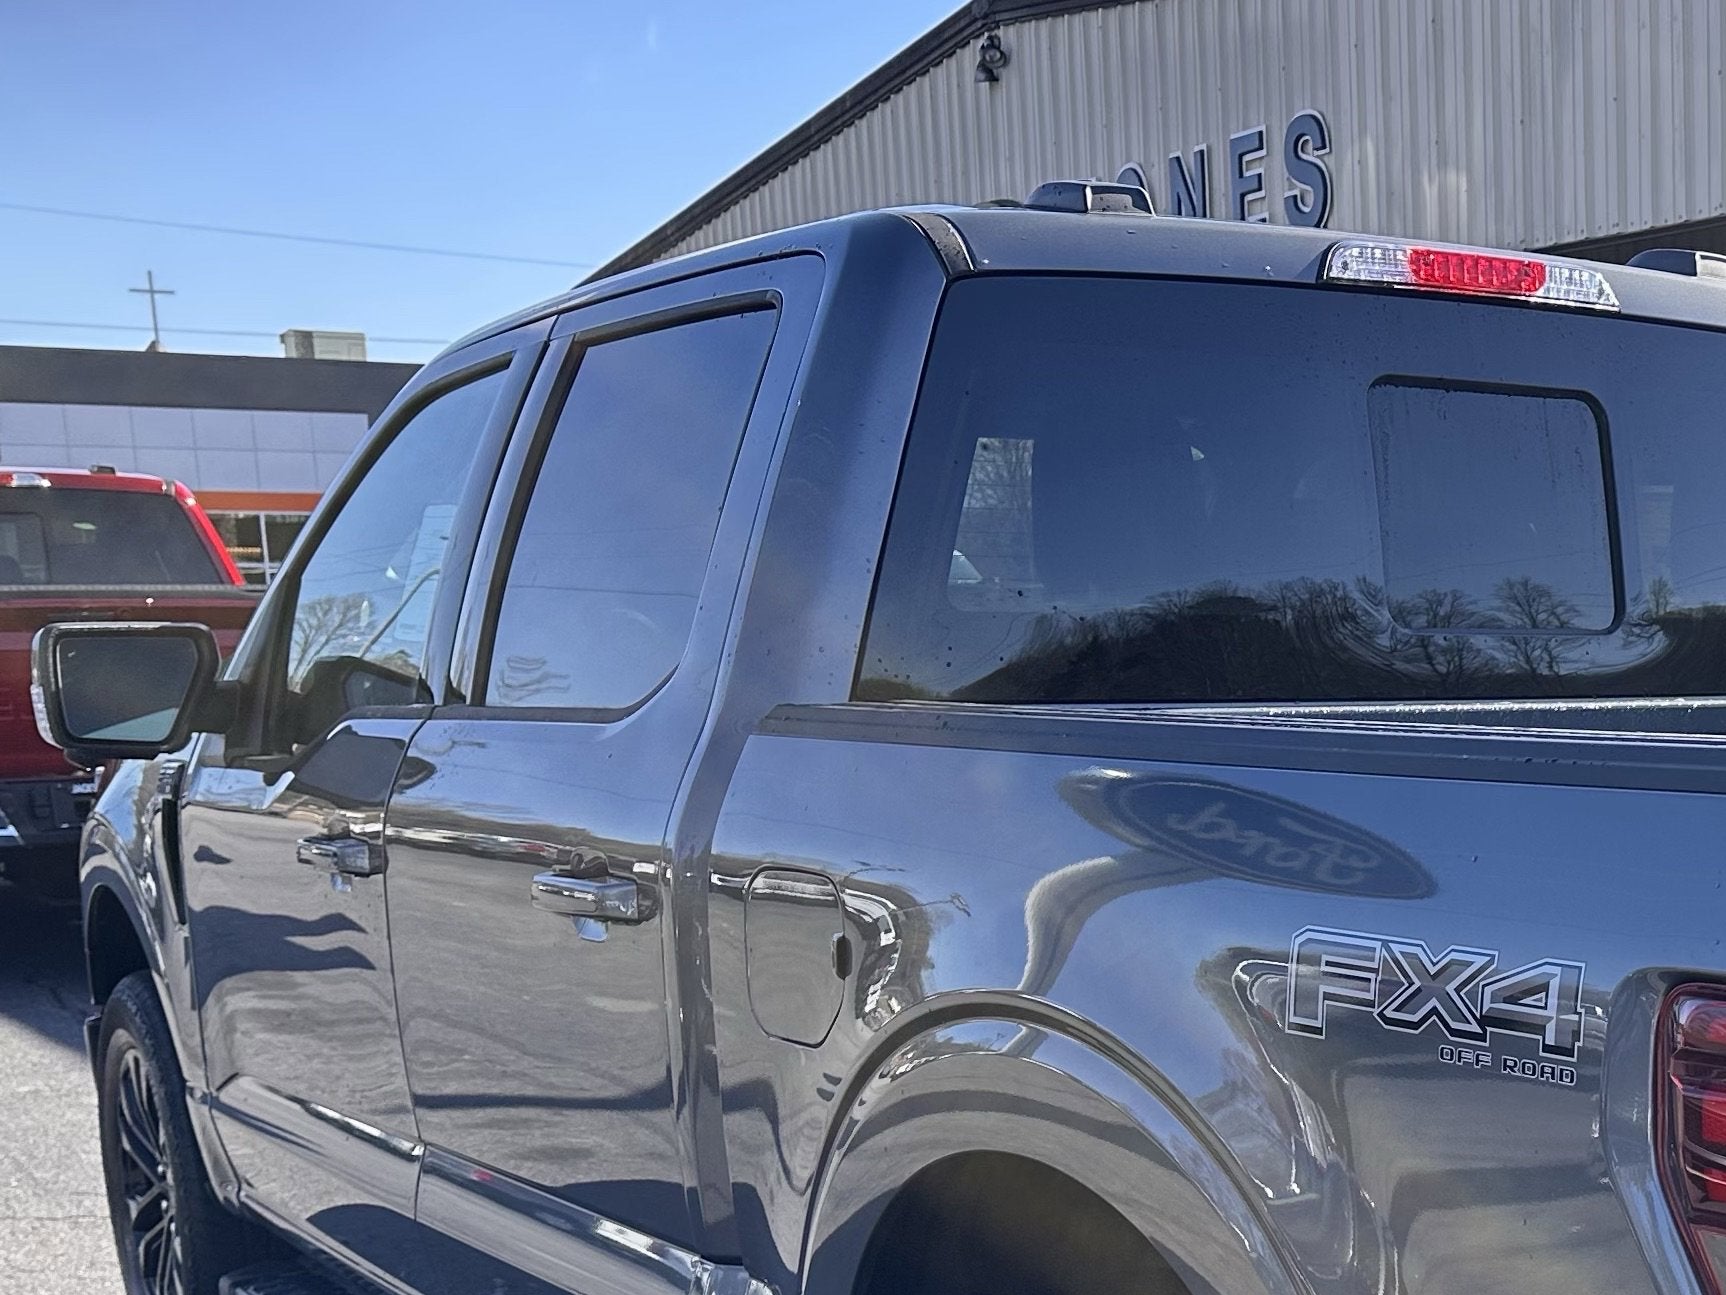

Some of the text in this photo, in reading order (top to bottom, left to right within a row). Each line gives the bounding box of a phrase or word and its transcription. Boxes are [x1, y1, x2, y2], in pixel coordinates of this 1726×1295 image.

[1285, 925, 1587, 1062] FX4
[1438, 1044, 1577, 1086] OFF ROAD
